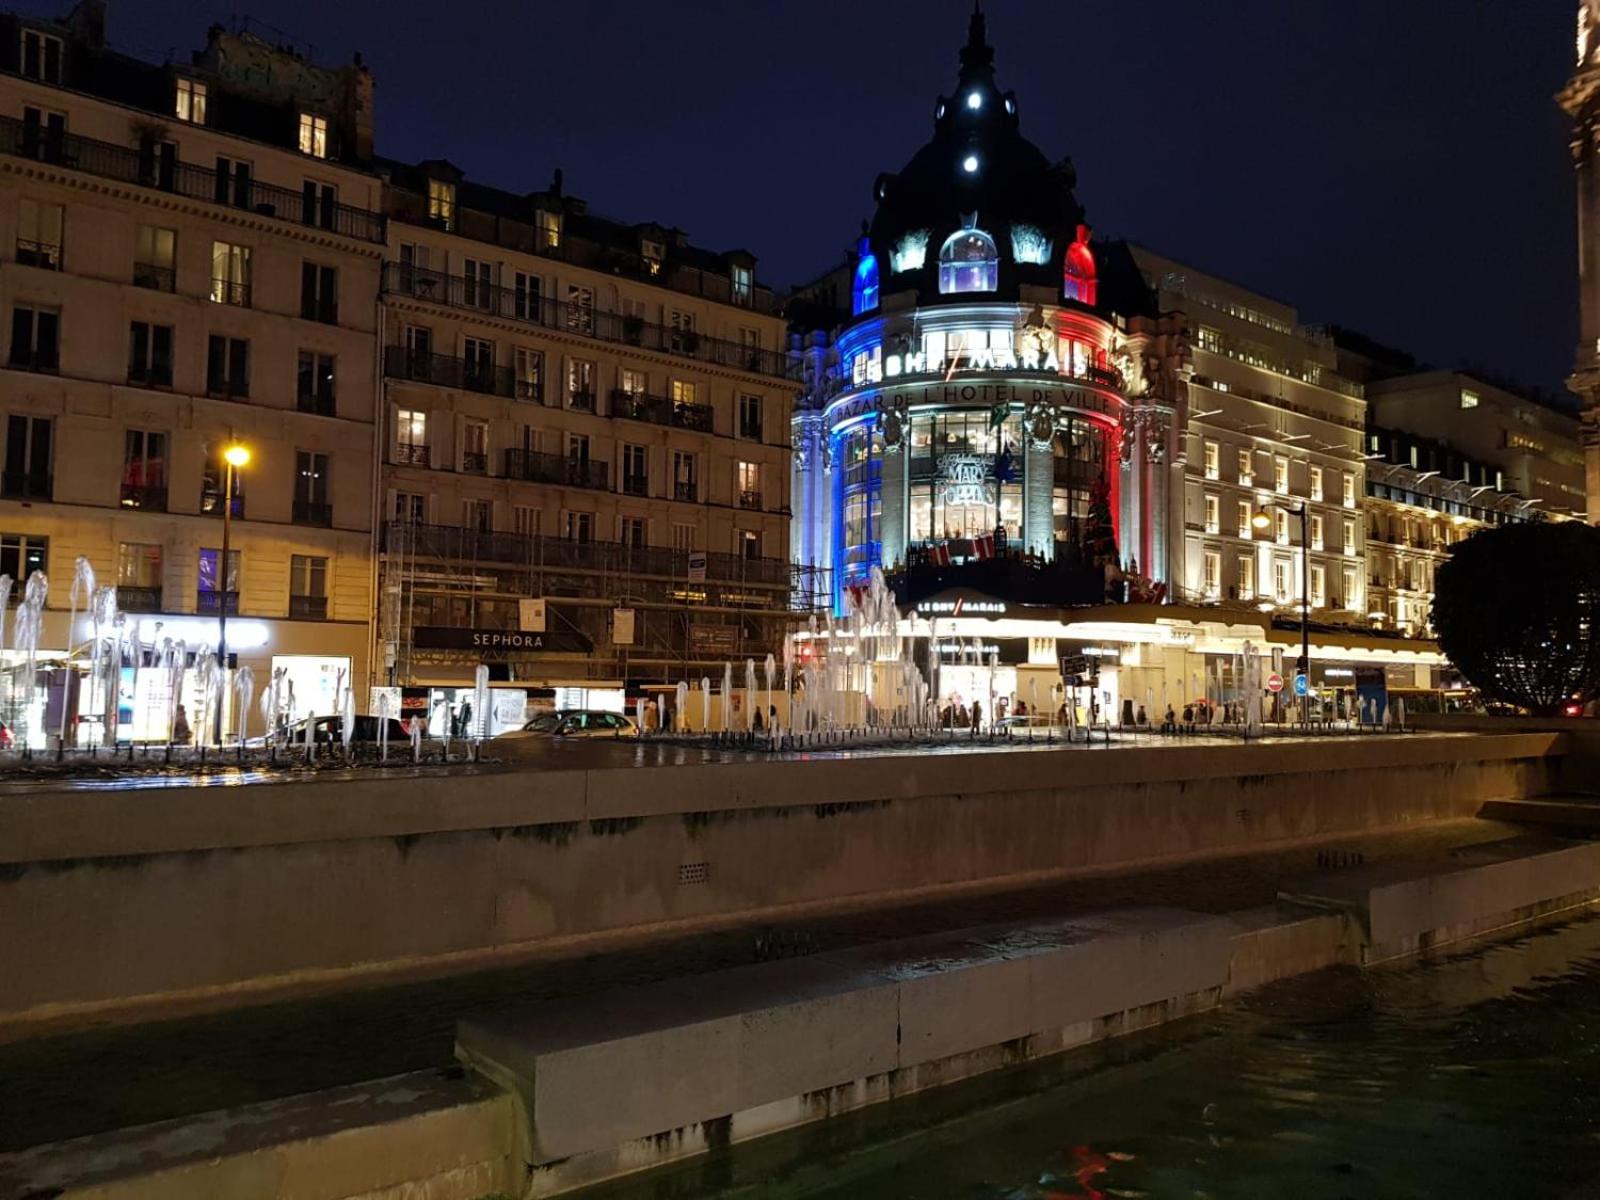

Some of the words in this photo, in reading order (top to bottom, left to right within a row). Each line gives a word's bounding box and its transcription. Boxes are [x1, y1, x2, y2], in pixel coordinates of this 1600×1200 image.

[968, 347, 1086, 375] MARAIS
[837, 394, 884, 419] BAZAR
[894, 394, 913, 406] DE
[1033, 389, 1053, 402] DE
[1062, 389, 1109, 412] VILLE
[948, 463, 988, 484] MARY
[918, 602, 930, 612] LE
[961, 602, 1006, 613] MARAIS
[473, 633, 543, 648] SEPHORA
